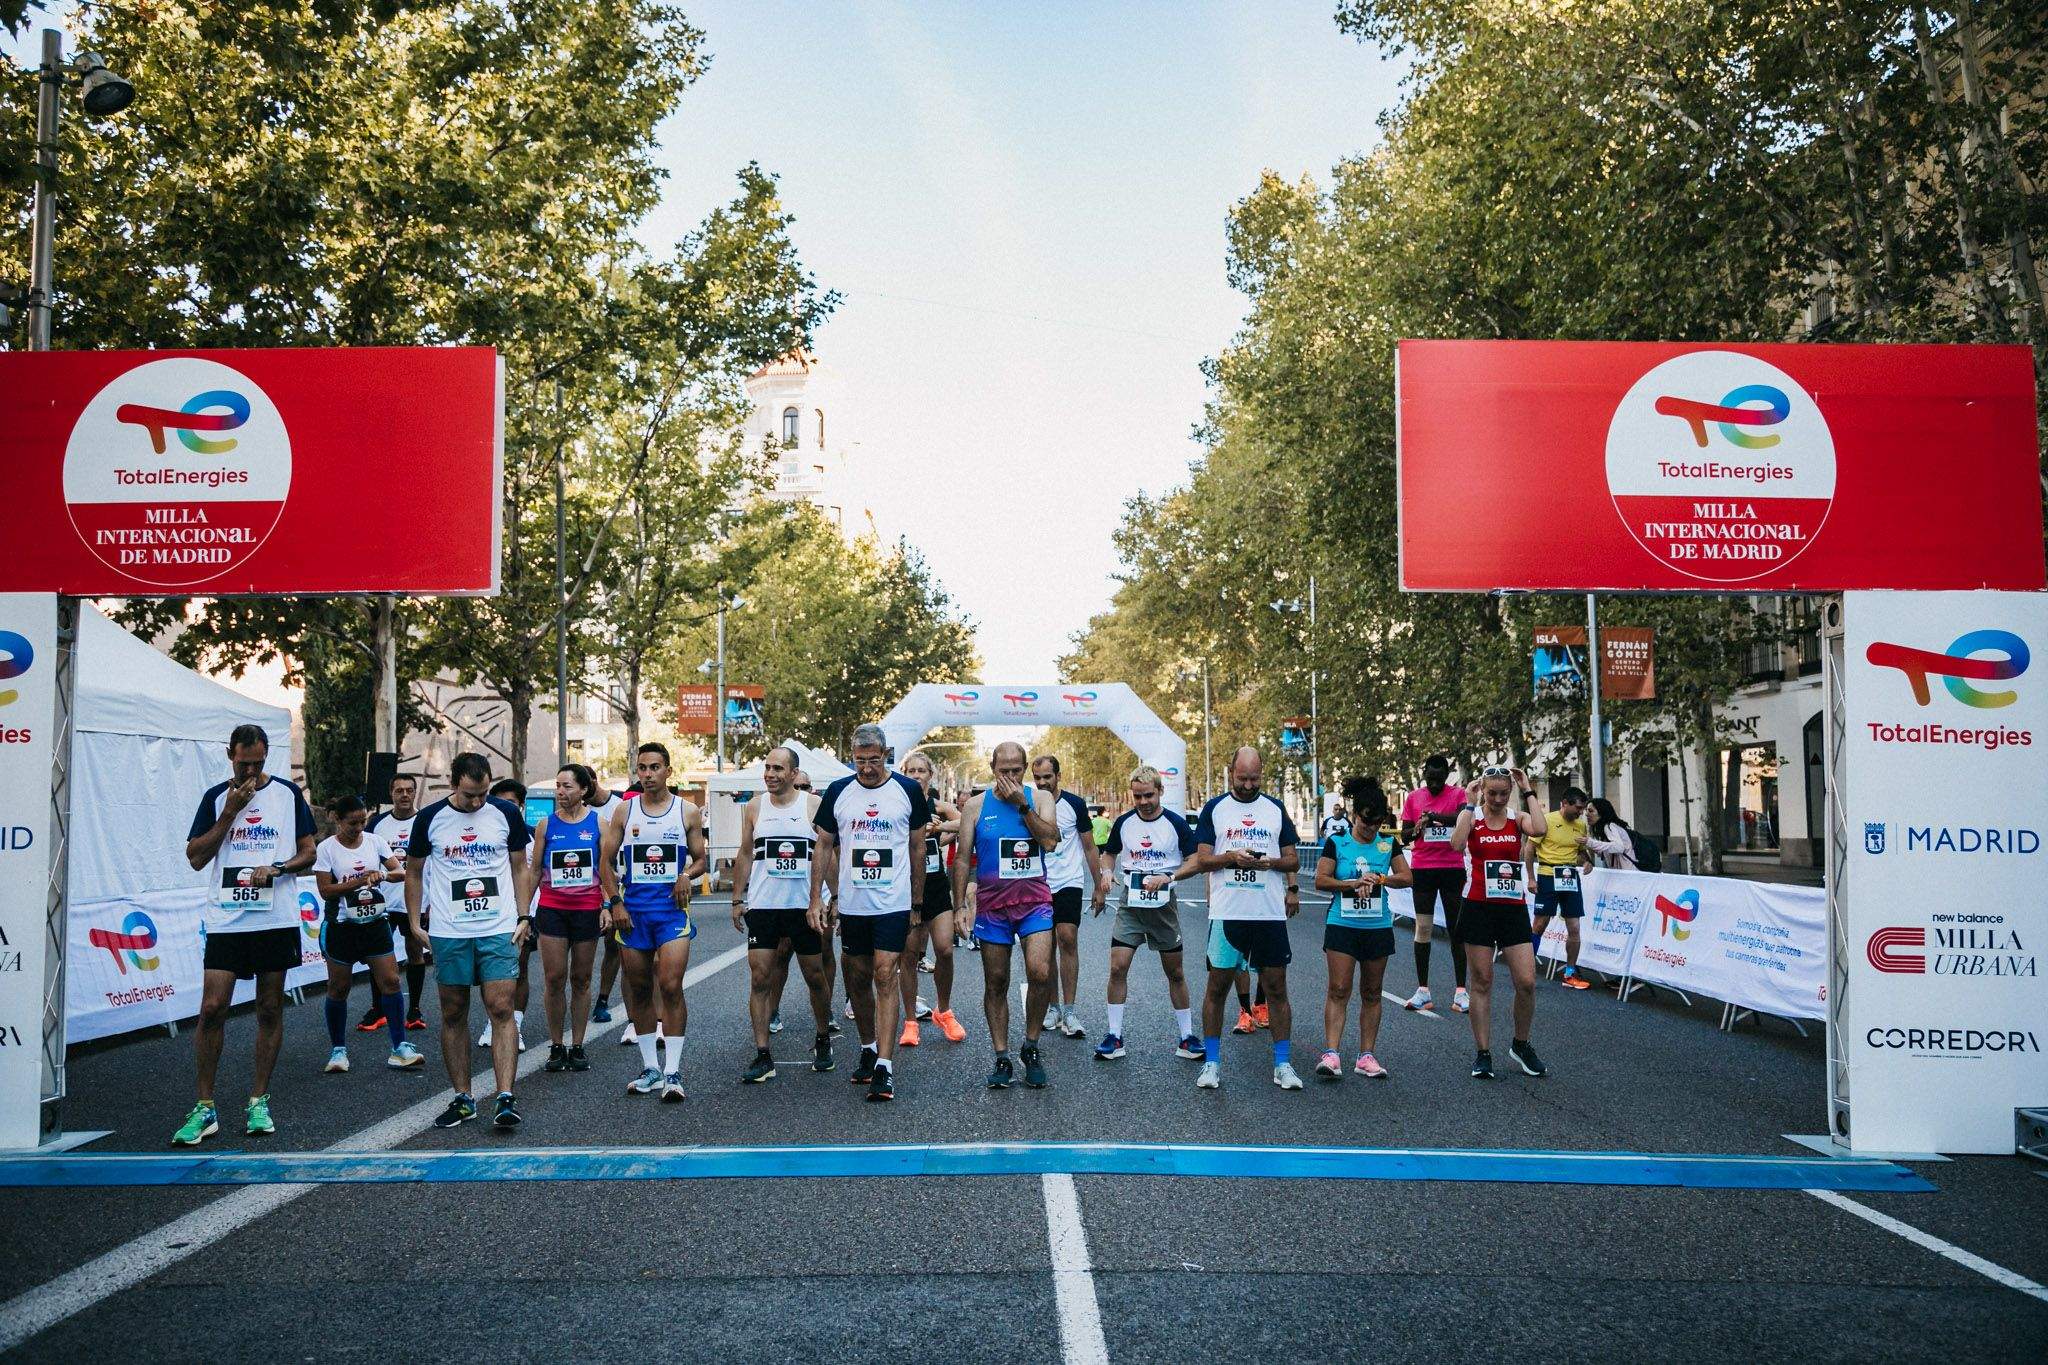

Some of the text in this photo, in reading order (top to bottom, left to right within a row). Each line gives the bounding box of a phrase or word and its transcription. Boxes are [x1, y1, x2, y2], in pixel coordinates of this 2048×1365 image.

[114, 467, 248, 487] TotalEnergies
[1657, 461, 1794, 483] TotalEnergies
[145, 509, 208, 524] MILLA
[1693, 503, 1757, 519] MILLA
[120, 548, 232, 565] DE MADRID
[1670, 543, 1782, 560] DE MADRID
[1536, 634, 1559, 644] ISLA
[1607, 641, 1648, 650] FERNÁN
[1607, 649, 1648, 659] GÓMEZ
[1868, 722, 2032, 749] TotalEnergies
[1431, 827, 1448, 836] 532
[1480, 835, 1517, 844] POLAND
[1908, 827, 2040, 854] MADRID
[643, 863, 666, 875] 533
[776, 858, 797, 870] 538
[1011, 858, 1031, 870] 549
[563, 868, 583, 880] 548
[861, 868, 882, 880] 537
[1234, 869, 1257, 882] 558
[1497, 880, 1516, 891] 550
[233, 888, 260, 901] 565
[1140, 891, 1159, 901] 544
[465, 898, 489, 912] 562
[1353, 898, 1372, 910] 561
[356, 904, 377, 918] 535
[1932, 913, 2004, 924] new balance
[1934, 928, 2024, 950] MILLA
[1934, 954, 2038, 976] URBANA
[106, 982, 175, 1008] TotalEnergies
